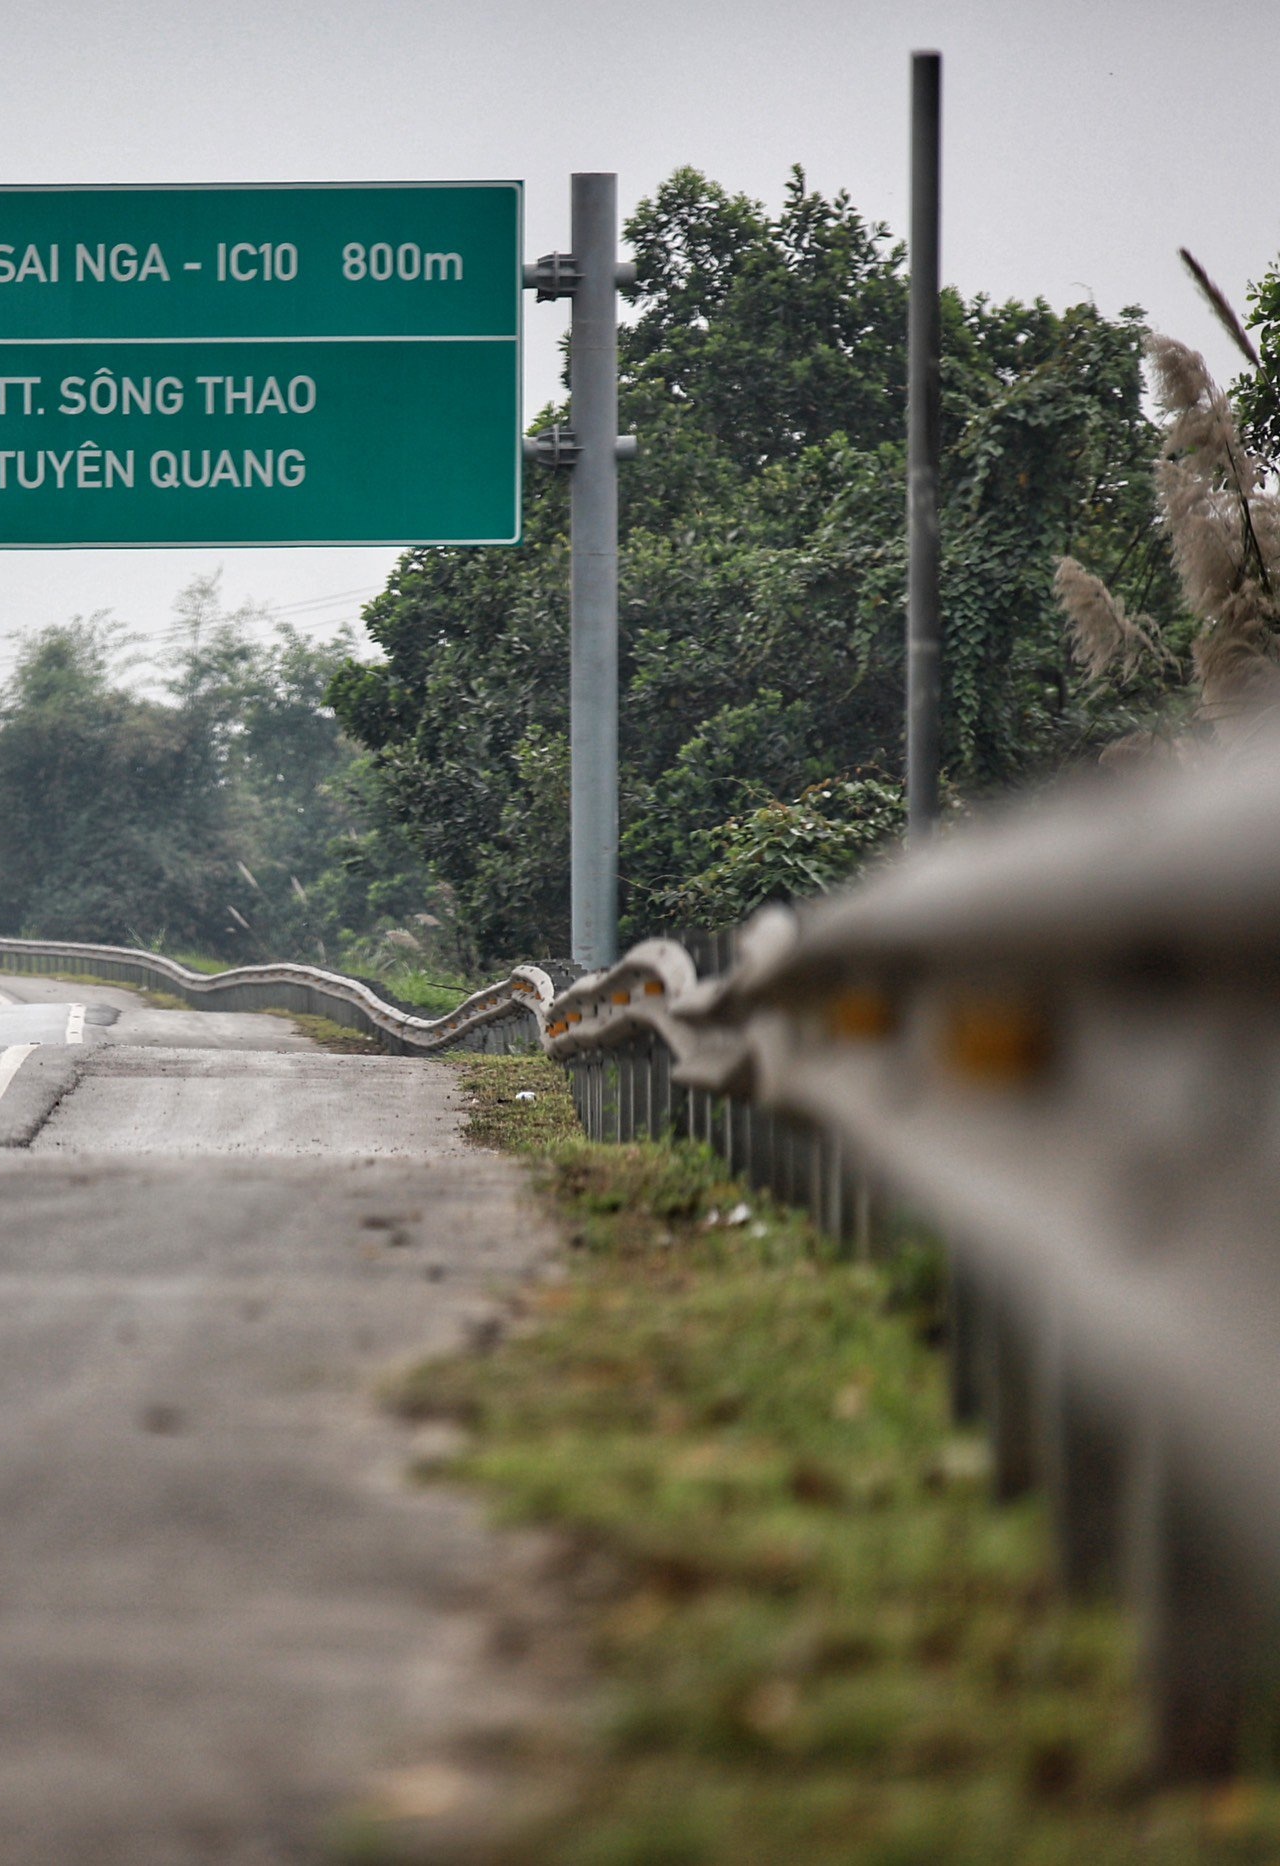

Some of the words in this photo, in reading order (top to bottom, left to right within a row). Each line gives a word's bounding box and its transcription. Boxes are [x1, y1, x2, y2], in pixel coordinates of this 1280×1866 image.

[75, 242, 171, 283] NGA
[216, 241, 299, 282] IC10
[341, 241, 464, 282] 800m
[57, 366, 184, 416] SÔNG
[195, 374, 317, 415] THAO
[149, 448, 307, 490] QUANG
